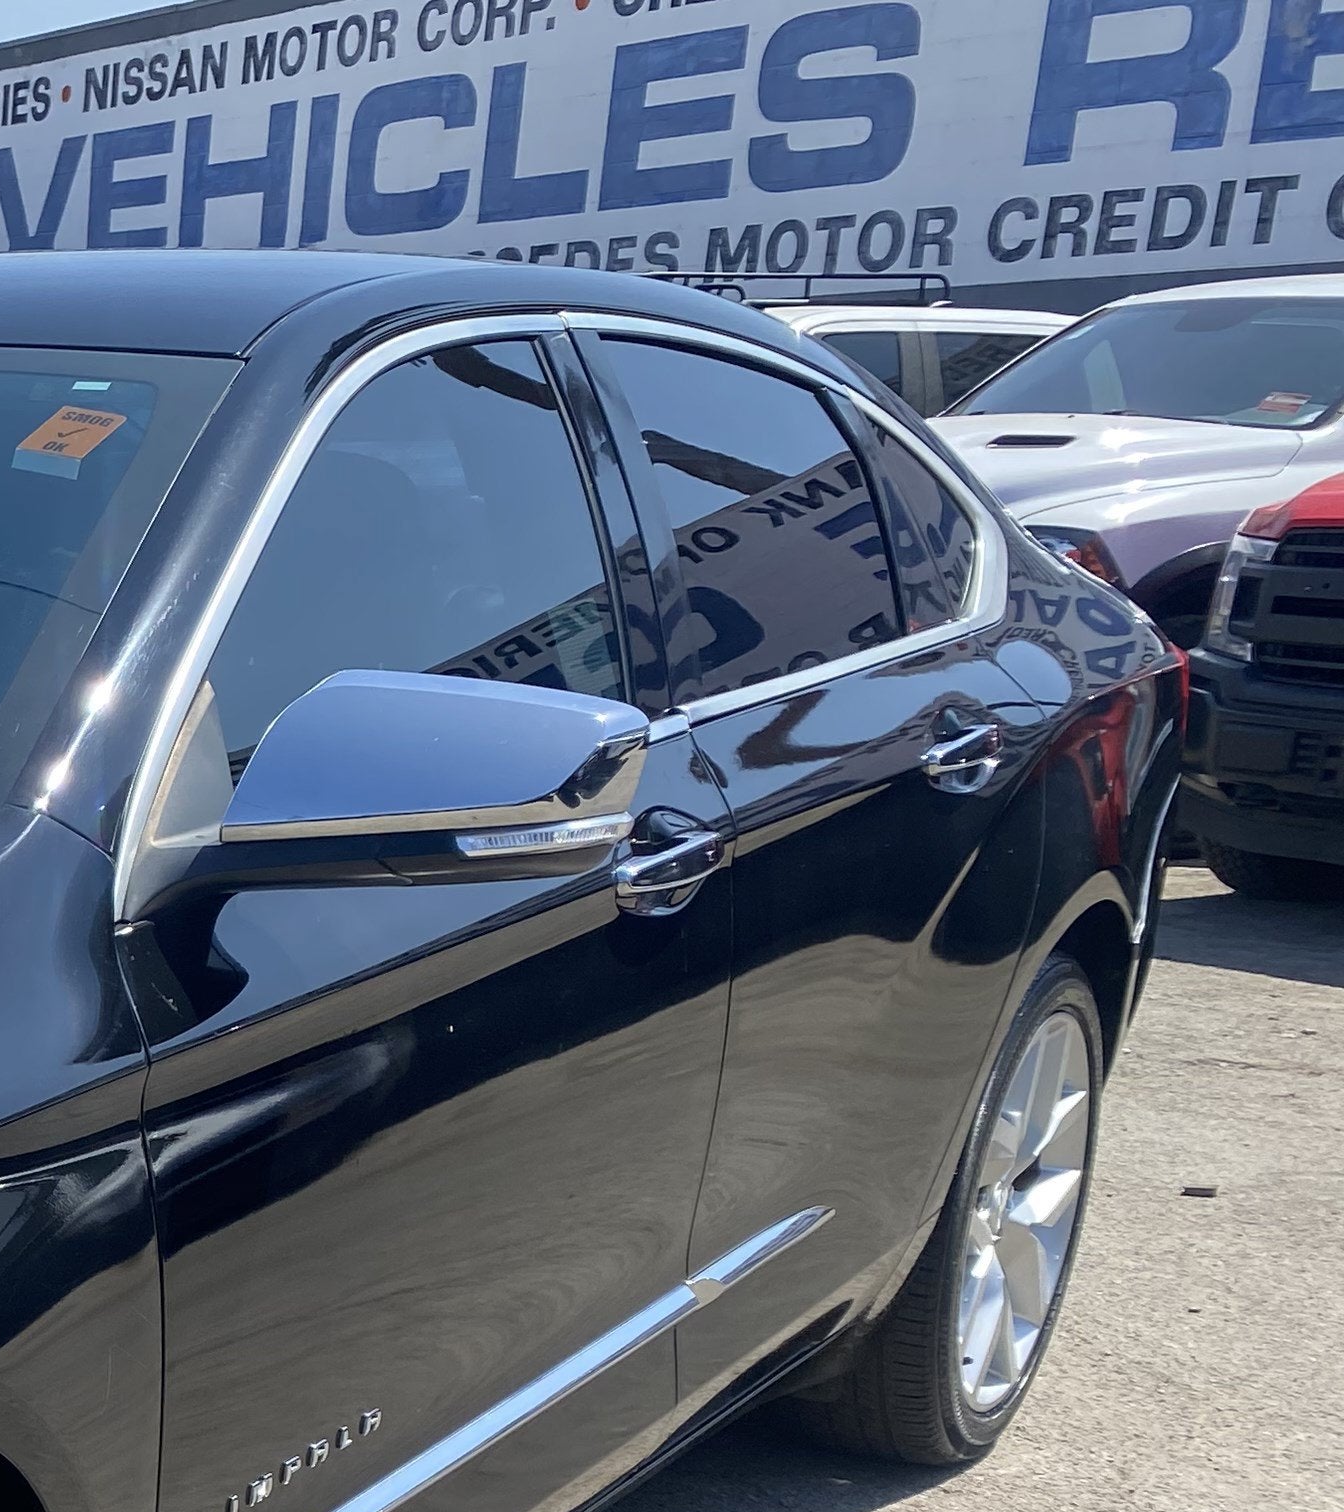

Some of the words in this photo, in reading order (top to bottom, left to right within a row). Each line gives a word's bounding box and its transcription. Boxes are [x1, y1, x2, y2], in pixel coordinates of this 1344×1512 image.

[84, 42, 228, 113] NISSAN
[242, 9, 400, 85] MOTOR
[705, 205, 960, 284] MOTOR
[987, 174, 1300, 264] CREDIT
[42, 440, 70, 453] OK
[61, 410, 115, 428] SMOG
